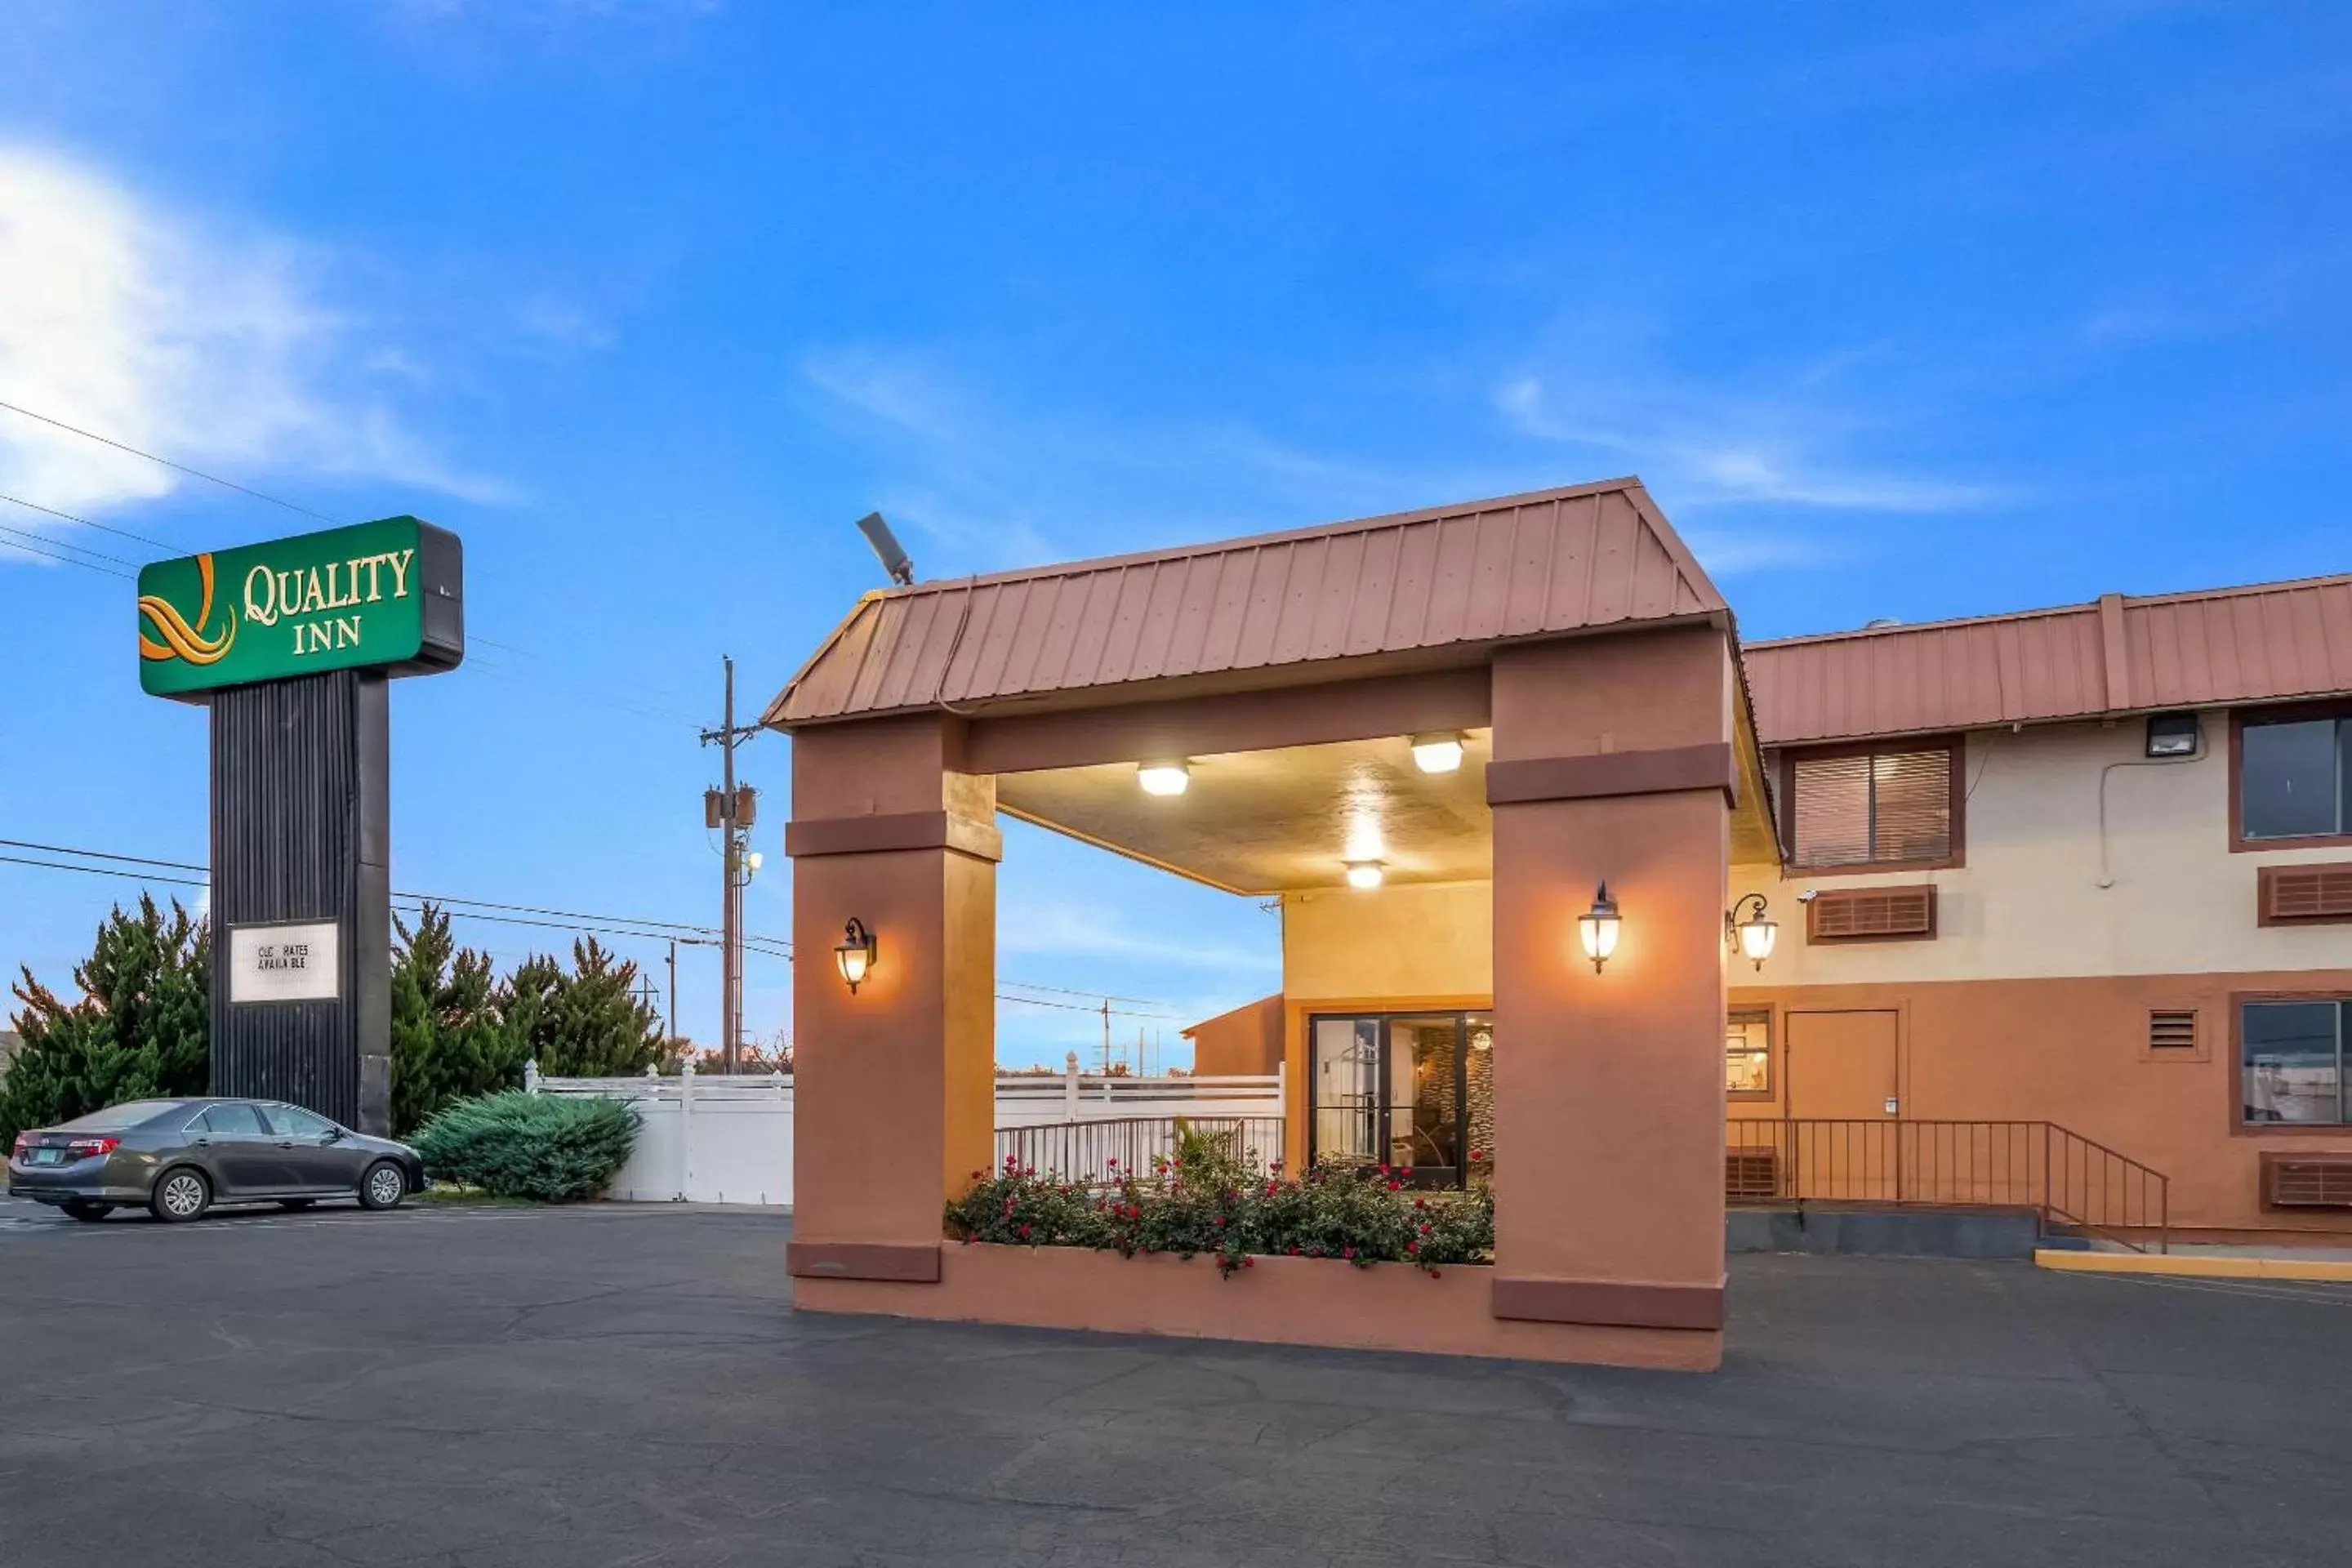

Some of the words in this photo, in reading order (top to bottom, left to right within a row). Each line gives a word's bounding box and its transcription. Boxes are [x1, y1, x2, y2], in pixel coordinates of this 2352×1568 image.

[245, 548, 413, 626] QUALITY
[293, 615, 362, 655] INN
[283, 945, 308, 956] RATES
